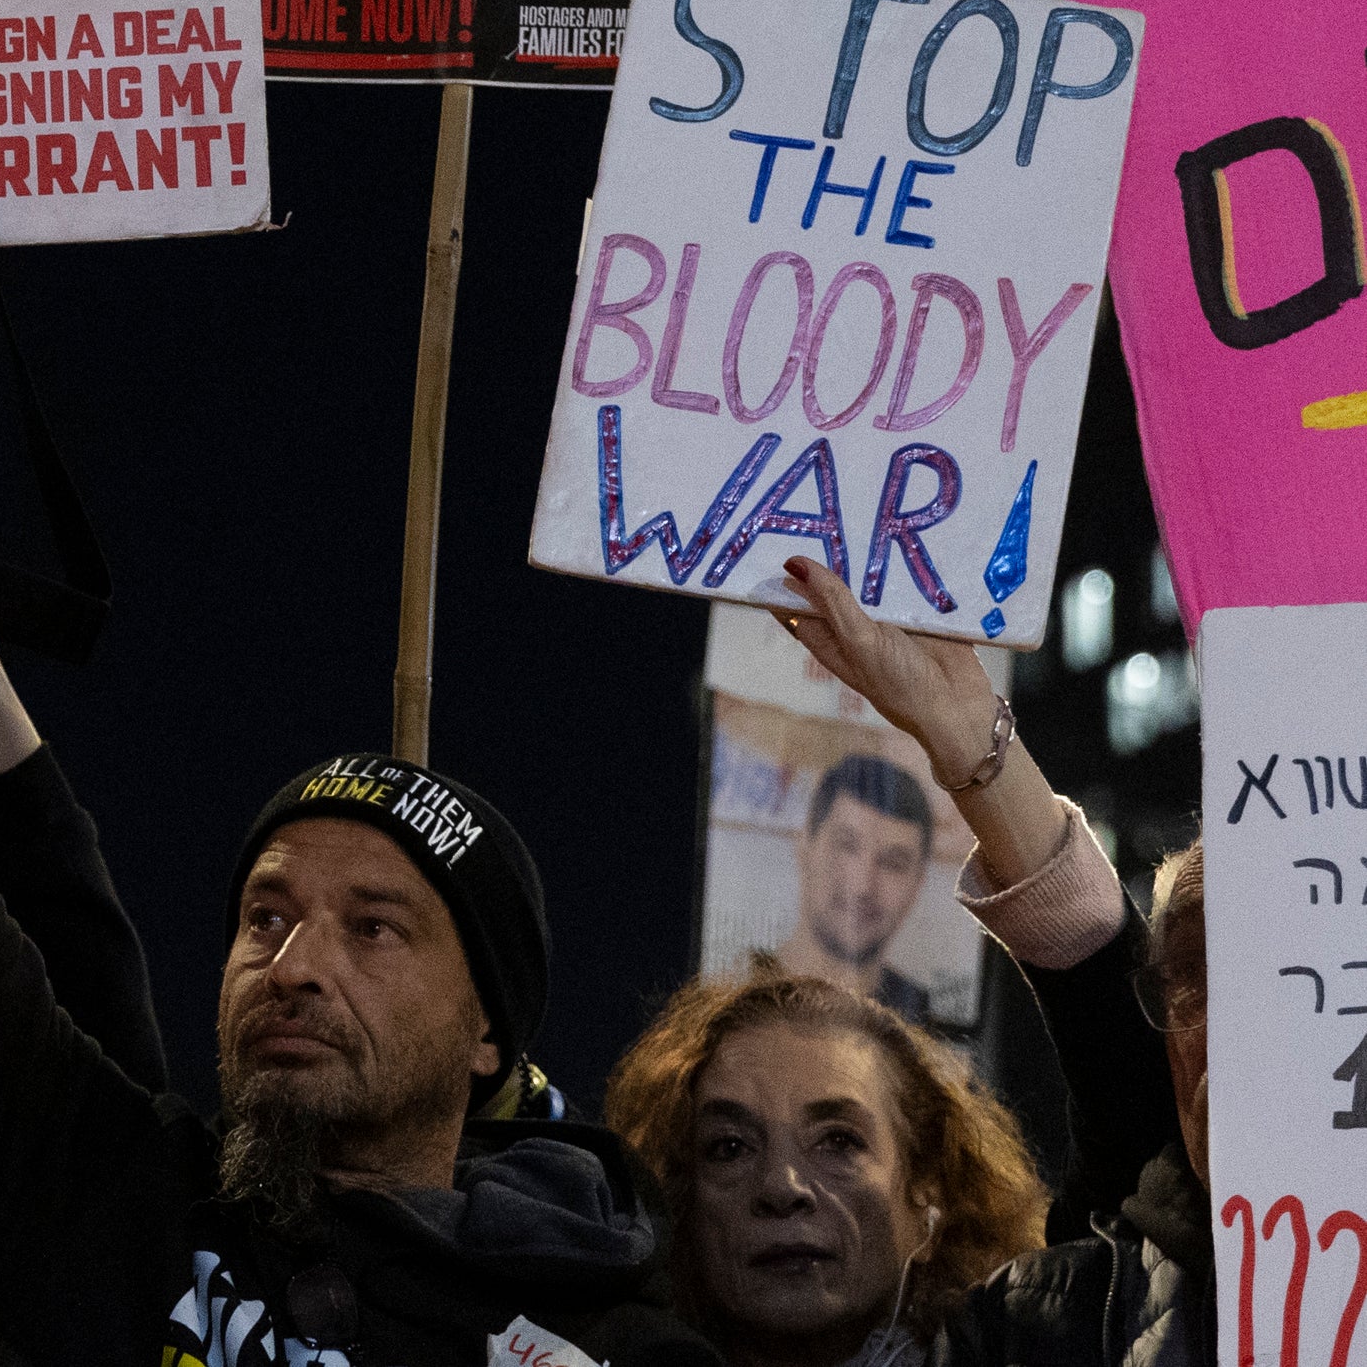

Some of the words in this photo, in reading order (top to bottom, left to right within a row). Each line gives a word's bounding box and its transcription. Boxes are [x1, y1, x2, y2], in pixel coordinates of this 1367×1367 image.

[67, 13, 105, 60] A
[113, 6, 242, 57] DEAL
[518, 26, 602, 58] FAMILIES
[519, 5, 585, 28] HOSTAGES
[587, 7, 613, 28] AND
[158, 60, 243, 118] MY
[729, 129, 955, 249] THE
[572, 233, 1094, 453] BLOODY
[300, 777, 394, 807] HOME
[391, 792, 466, 870] NOW!
[319, 758, 378, 779] ALL
[380, 767, 404, 781] OF
[408, 771, 483, 846] THEM
